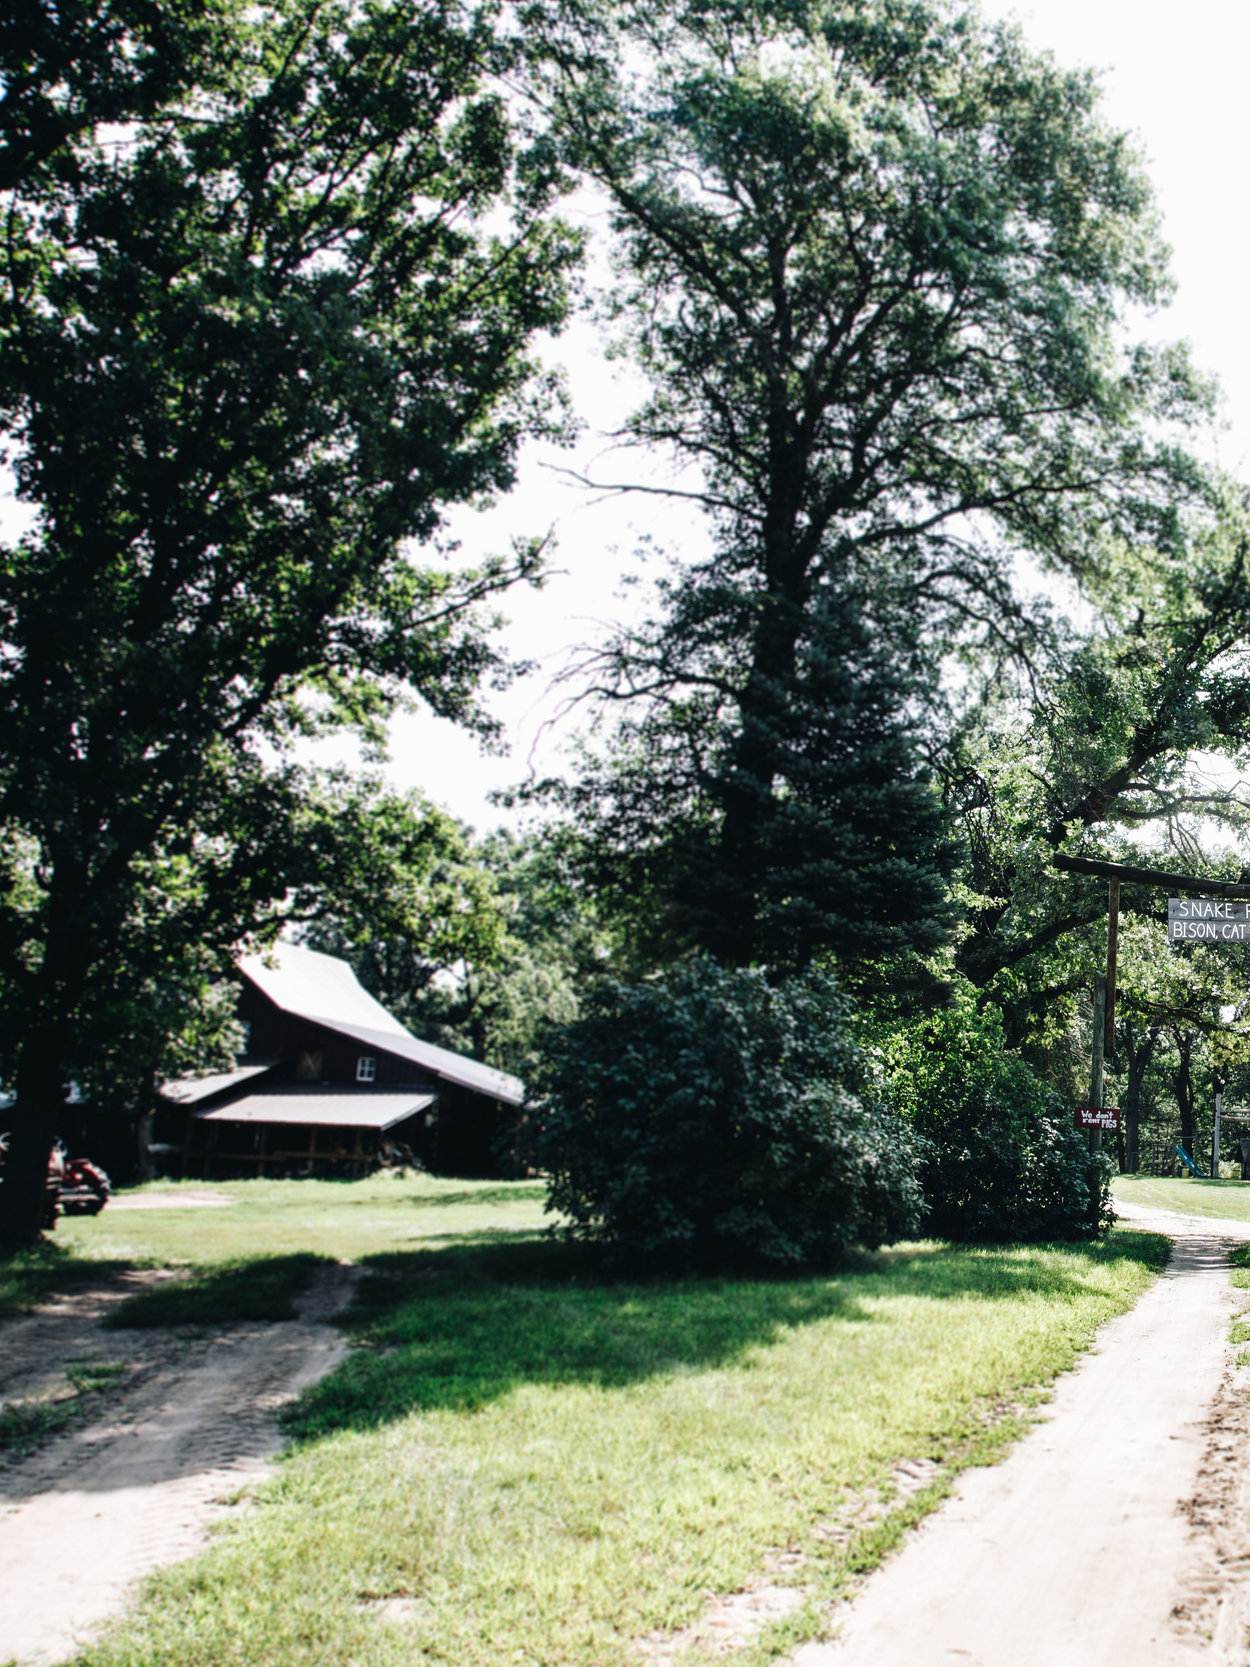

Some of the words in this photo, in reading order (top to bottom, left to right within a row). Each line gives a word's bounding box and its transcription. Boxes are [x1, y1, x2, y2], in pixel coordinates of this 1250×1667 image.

[1179, 901, 1235, 919] SNAKE
[1173, 922, 1219, 940] BISON,
[1081, 1110, 1093, 1119] We
[1095, 1110, 1113, 1119] don't
[1101, 1119, 1117, 1128] PIGS
